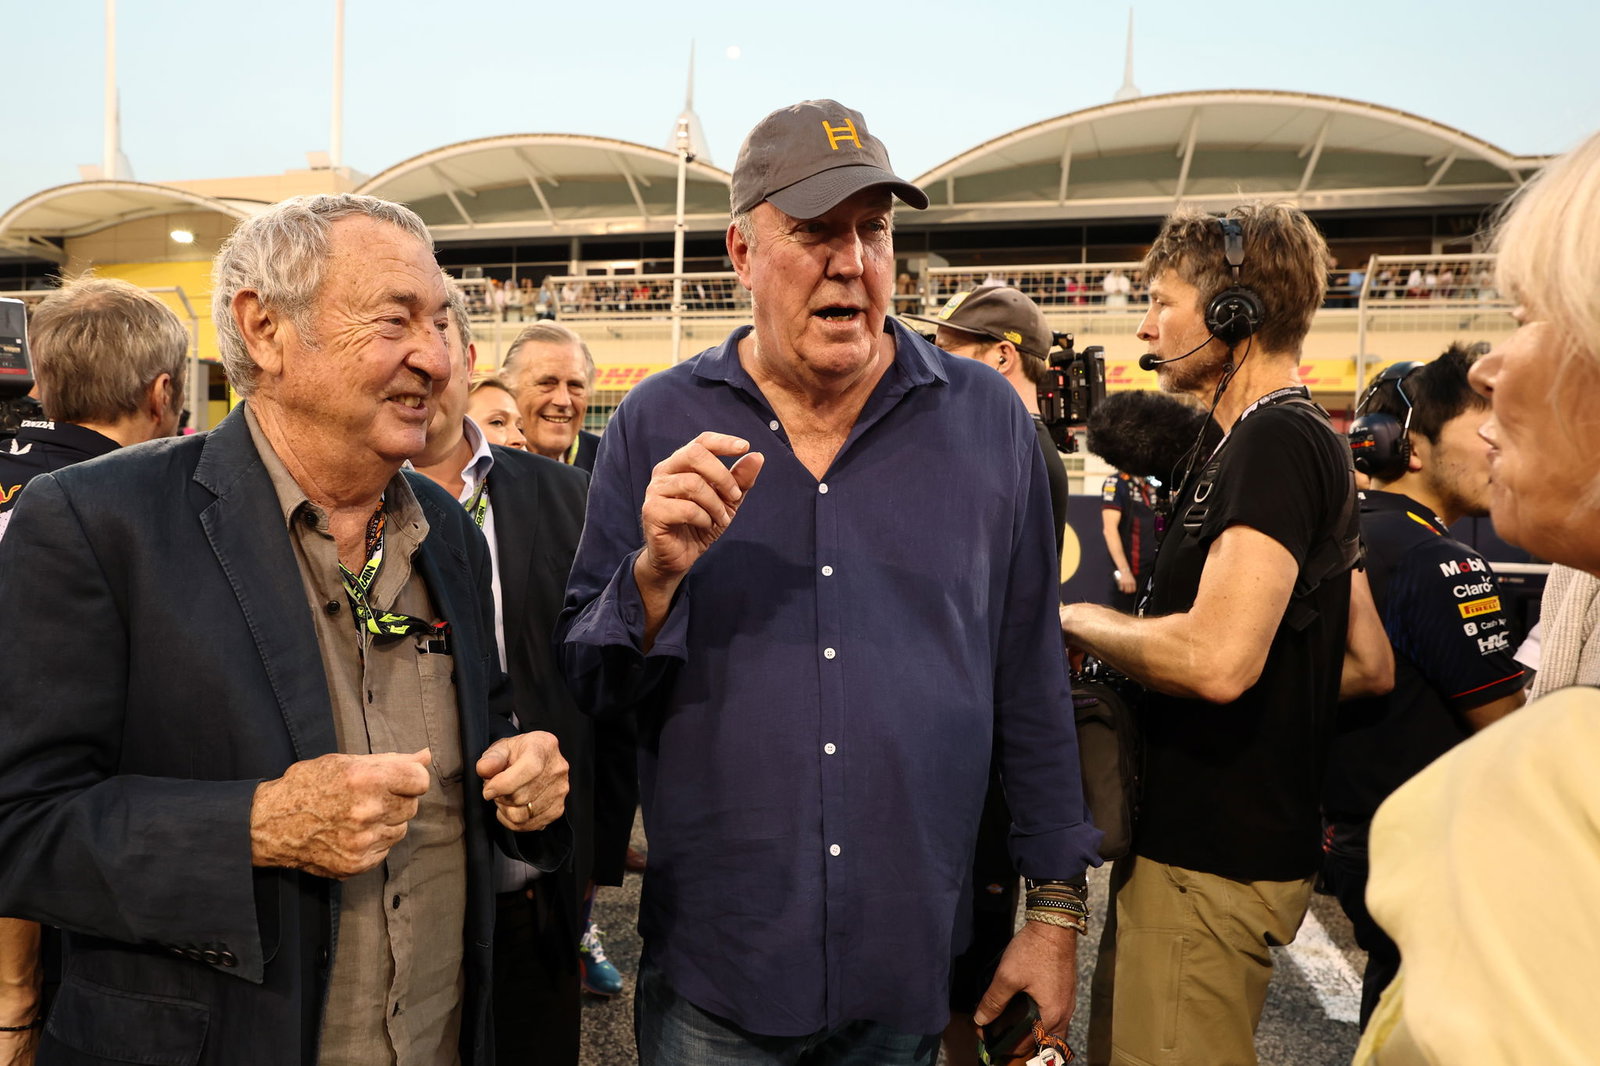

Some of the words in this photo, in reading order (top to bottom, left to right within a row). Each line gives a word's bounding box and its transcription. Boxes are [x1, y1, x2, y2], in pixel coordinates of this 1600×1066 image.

[822, 118, 862, 150] H
[20, 419, 55, 430] ONDA
[1453, 575, 1493, 598] Claro
